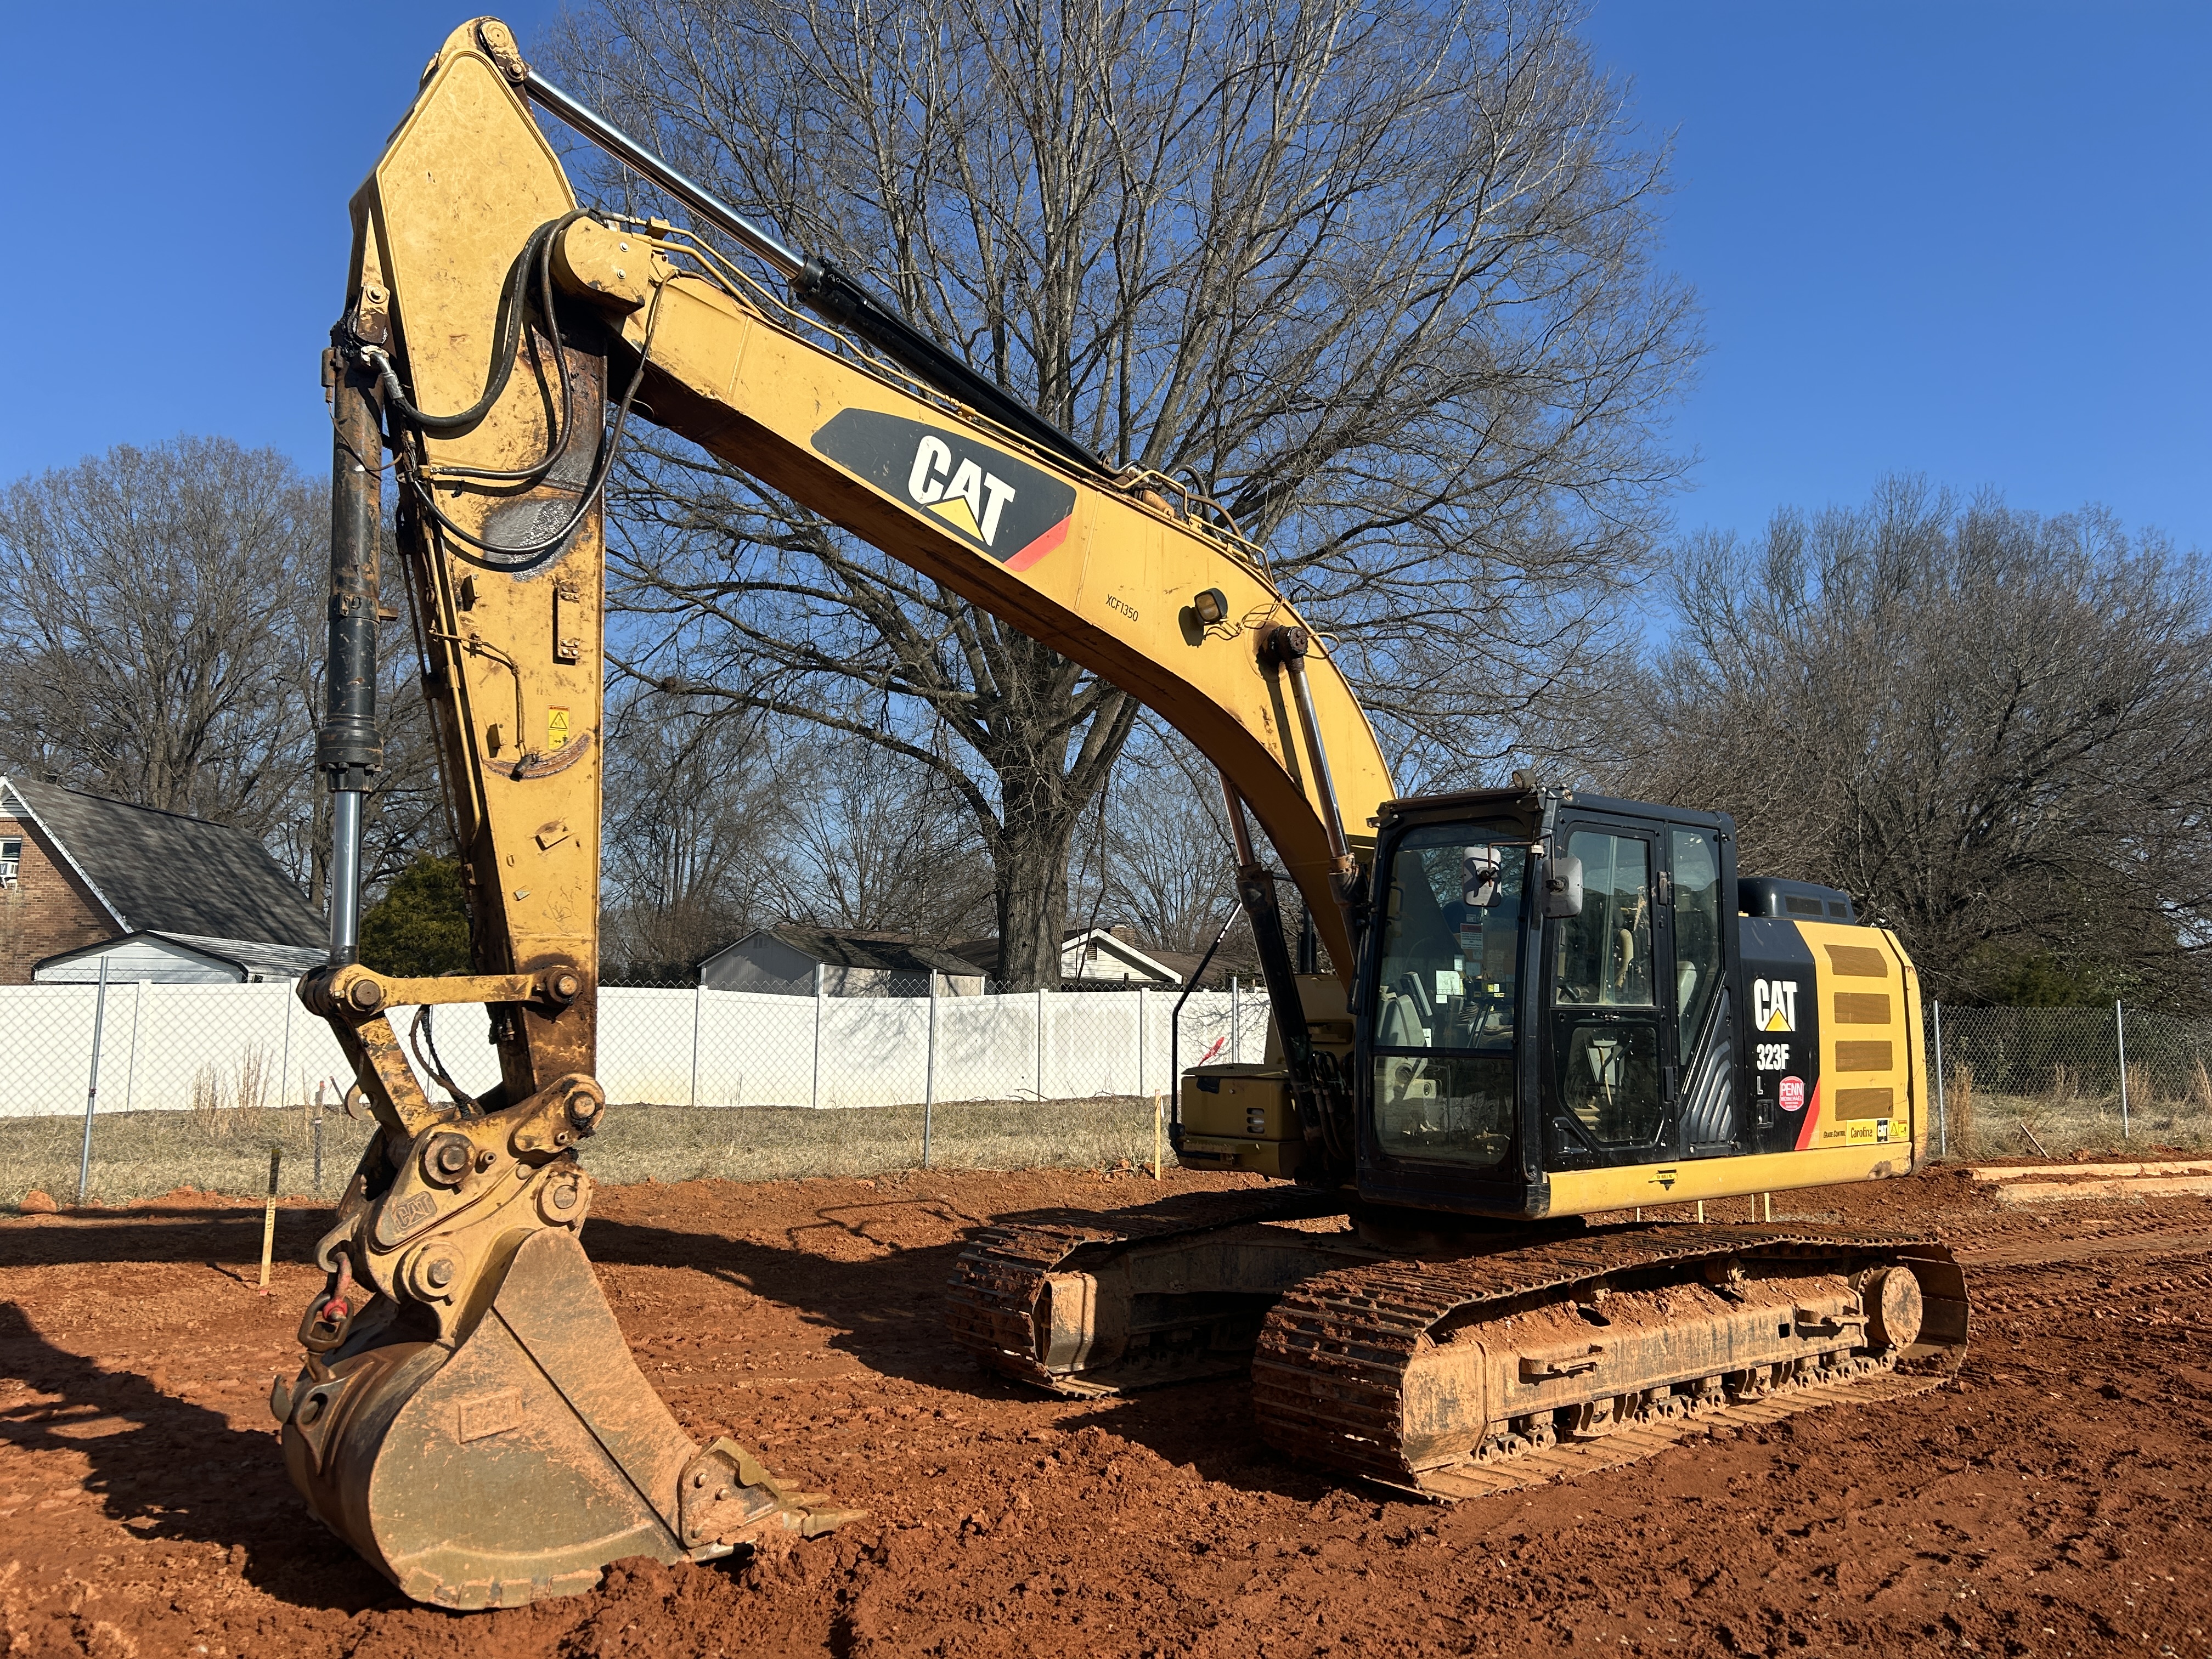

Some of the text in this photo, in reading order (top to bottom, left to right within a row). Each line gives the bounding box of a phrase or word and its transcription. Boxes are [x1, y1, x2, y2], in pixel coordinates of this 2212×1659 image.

[908, 435, 1016, 547] CAT
[1105, 593, 1138, 622] XCF1350
[1754, 979, 1797, 1031] CAT
[1757, 1044, 1789, 1070] 323F
[1757, 1076, 1763, 1094] L
[1781, 1082, 1803, 1096] PENN
[1851, 1125, 1887, 1138] Carolina CAT
[396, 1195, 431, 1228] CAT
